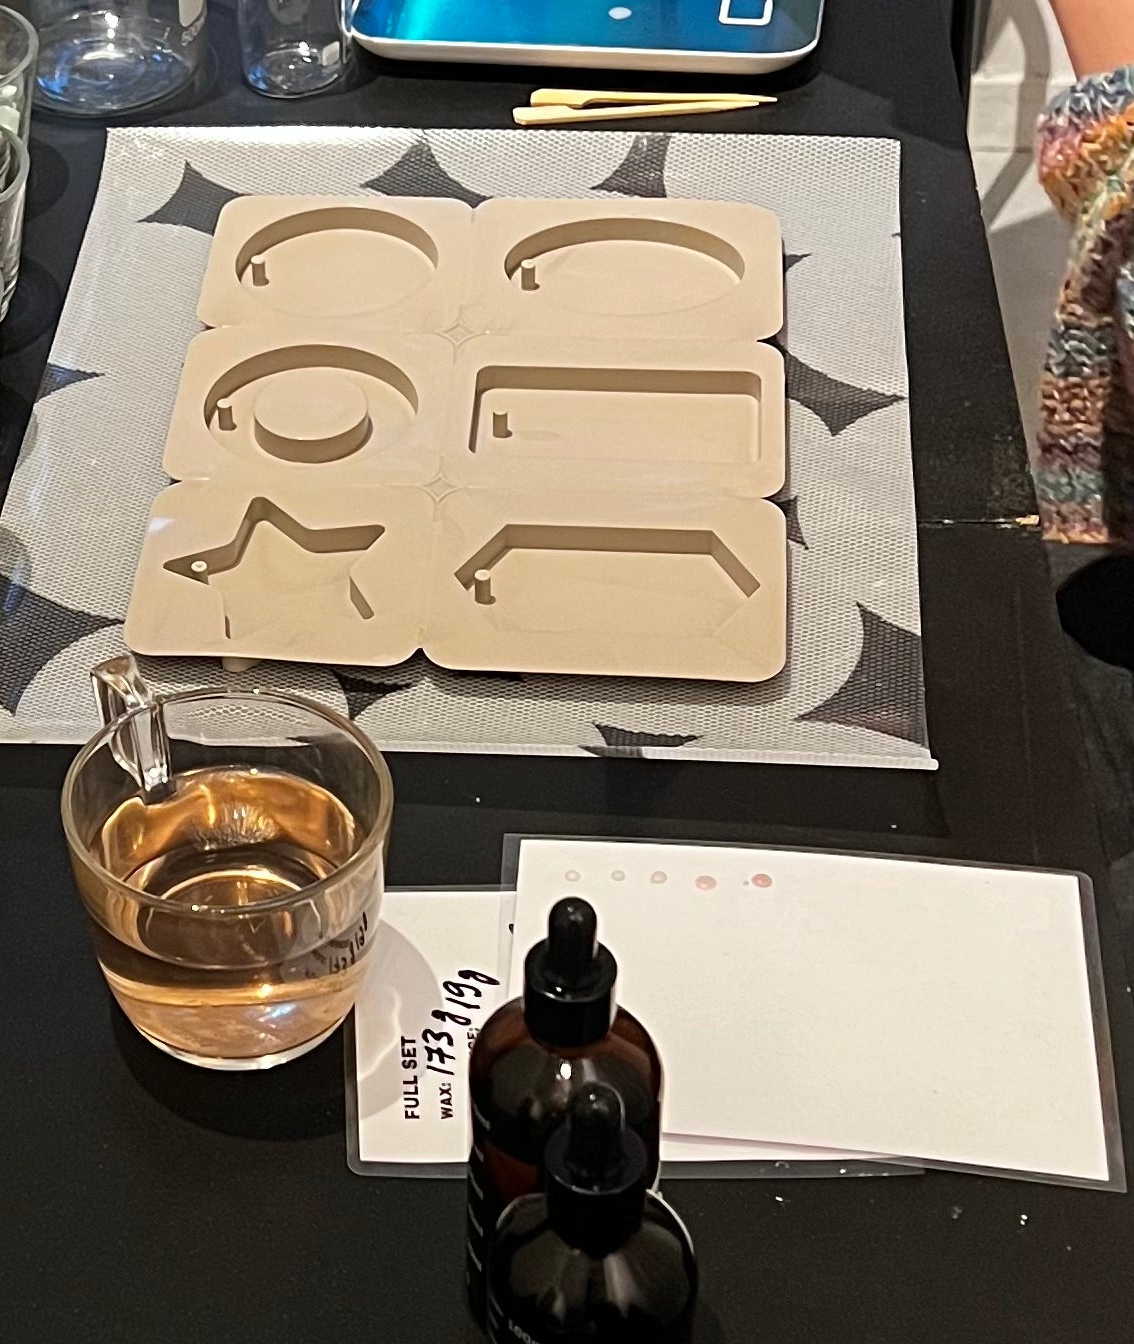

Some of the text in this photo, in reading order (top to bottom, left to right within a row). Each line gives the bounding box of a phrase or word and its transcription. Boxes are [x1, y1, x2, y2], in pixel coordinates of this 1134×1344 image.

[400, 1035, 420, 1120] FULL SET
[438, 1082, 454, 1120] WAX:
